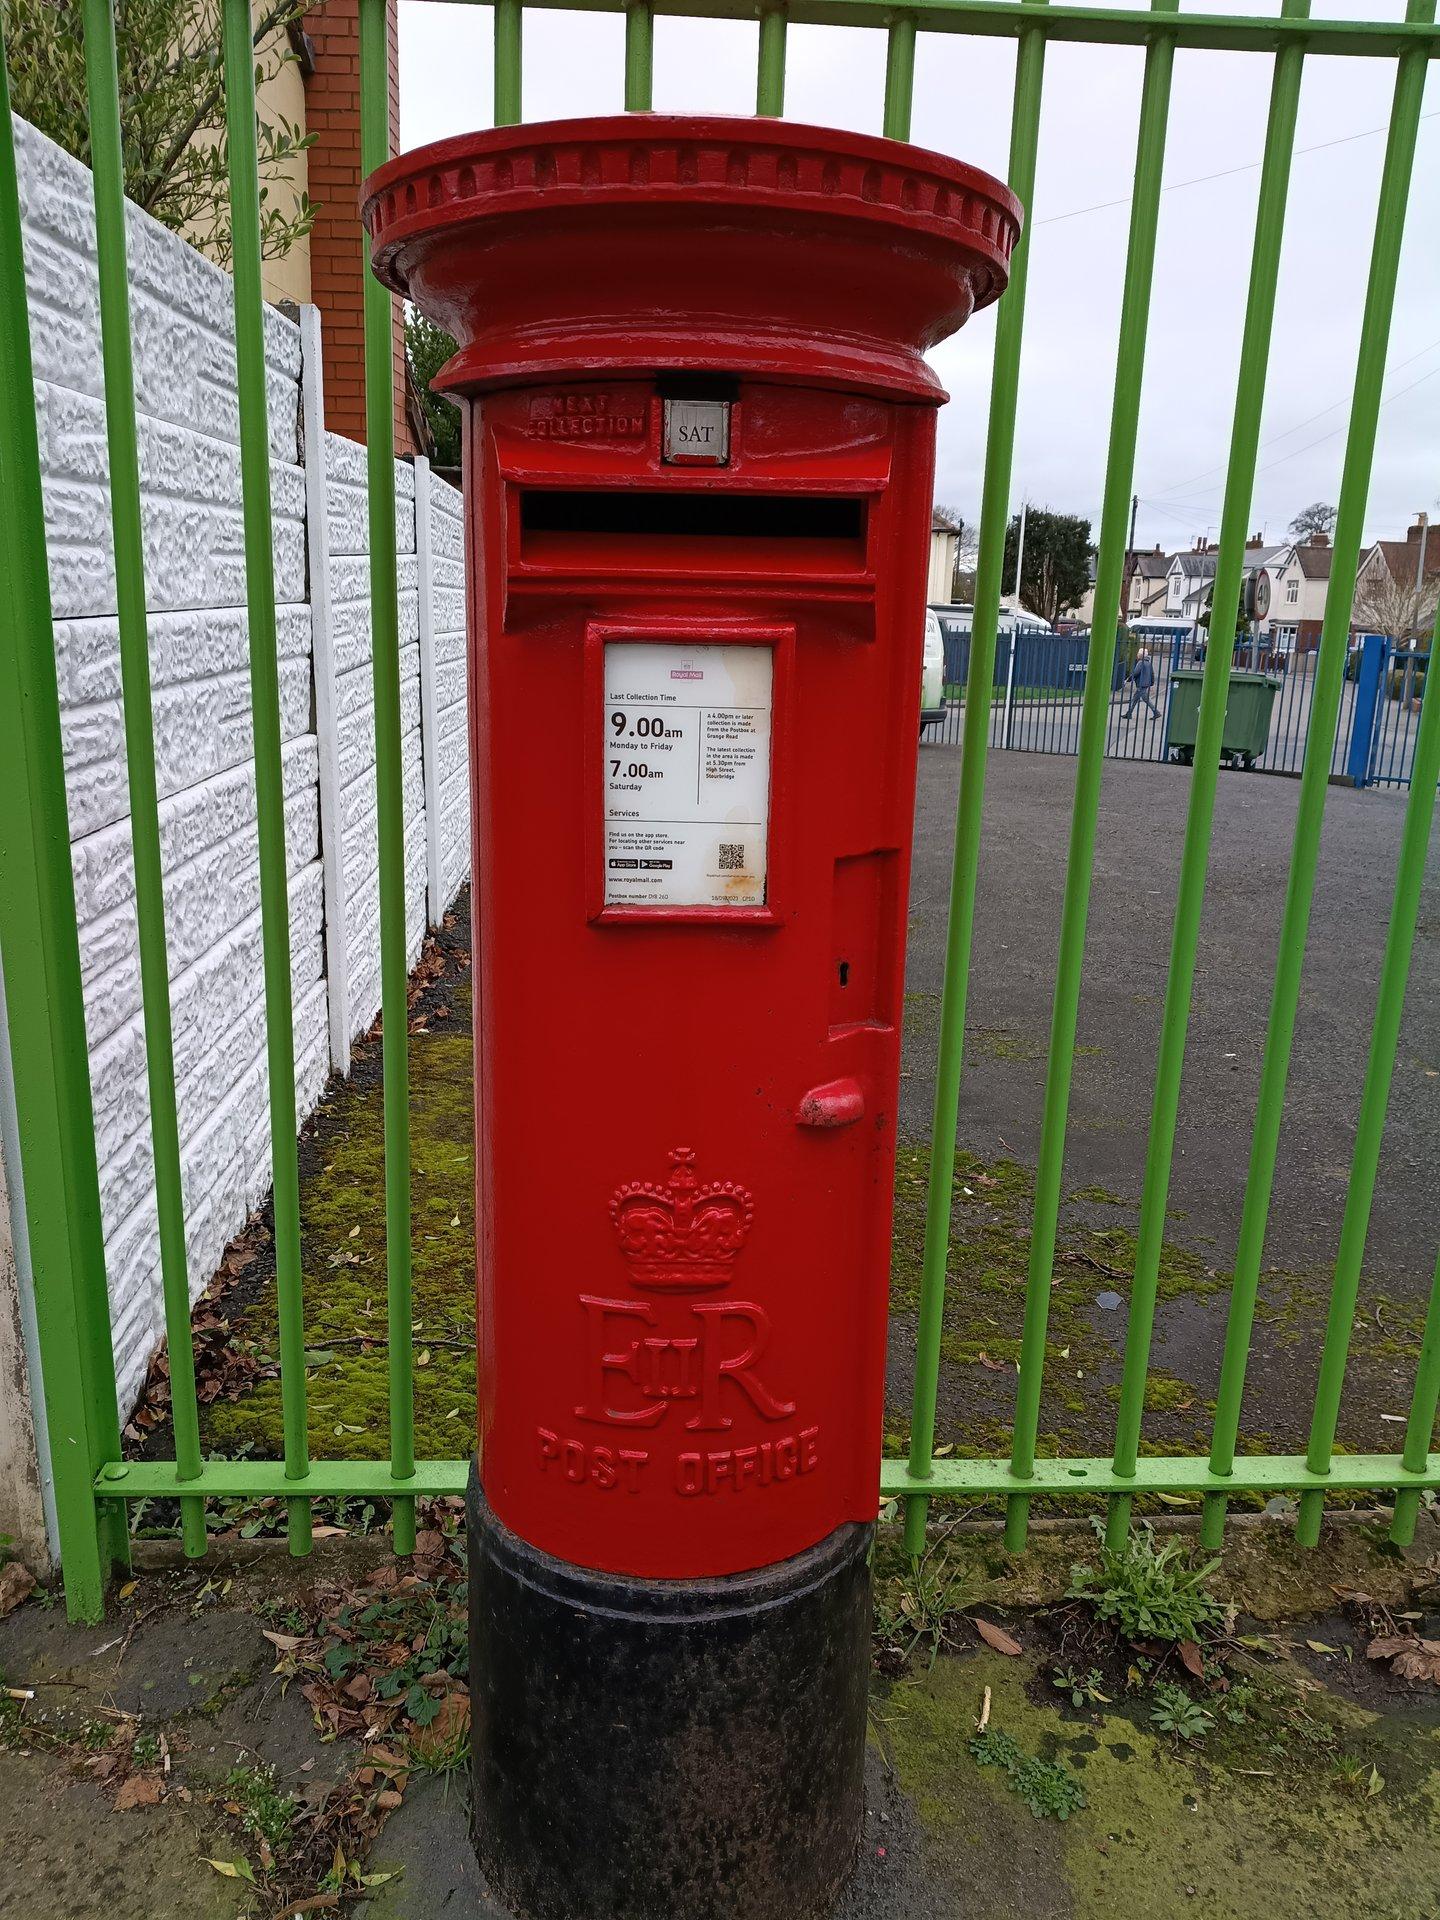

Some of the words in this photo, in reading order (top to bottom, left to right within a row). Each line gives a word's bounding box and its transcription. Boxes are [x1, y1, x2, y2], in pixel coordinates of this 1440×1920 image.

[528, 417, 643, 436] COLLECTION
[679, 426, 714, 443] SAT
[626, 693, 658, 701] Collection
[611, 711, 683, 738] 9.00am
[610, 741, 638, 750] Monday
[650, 742, 673, 752] Friday
[609, 759, 664, 778] 7.00am
[609, 782, 642, 791] Saturday
[609, 809, 640, 817] Services
[685, 1301, 797, 1432] R
[537, 1426, 649, 1494] POST
[676, 1425, 820, 1496] OFFICE
